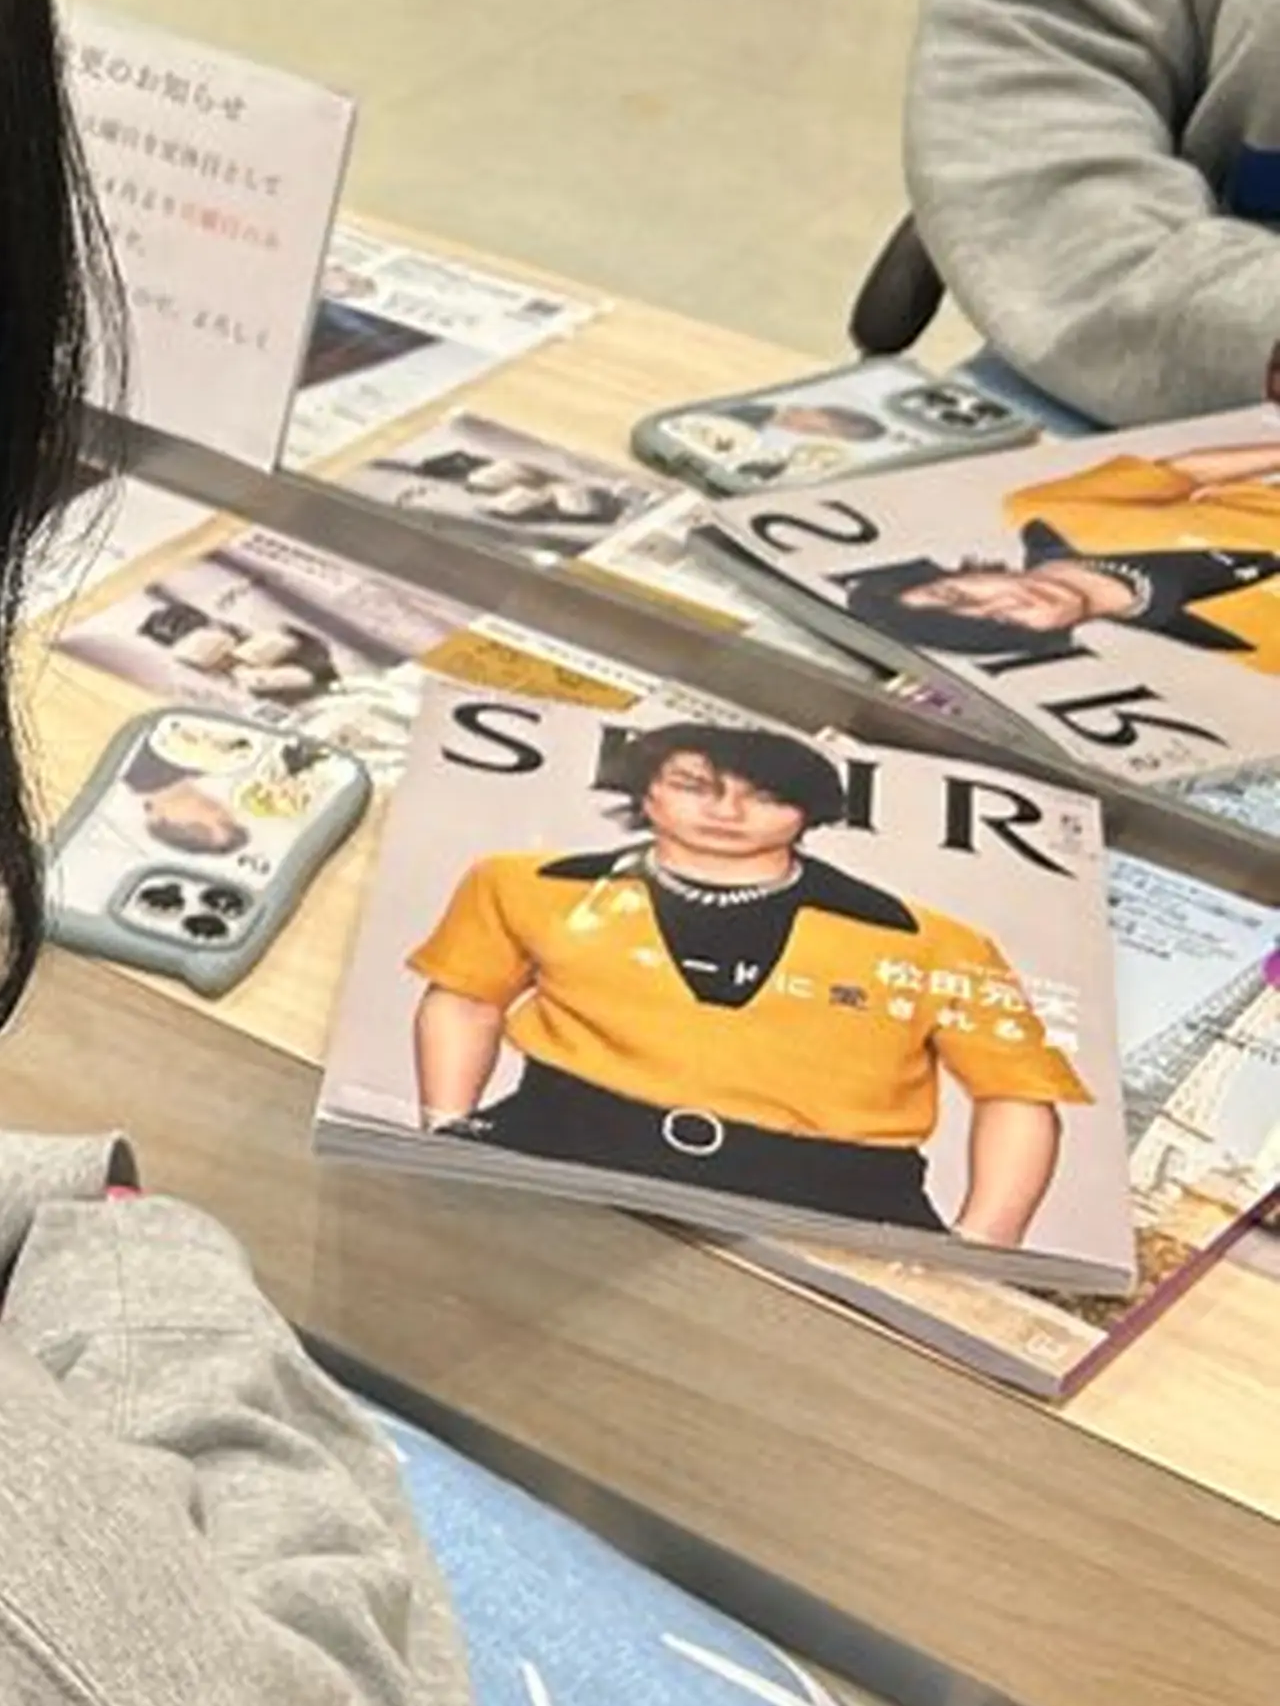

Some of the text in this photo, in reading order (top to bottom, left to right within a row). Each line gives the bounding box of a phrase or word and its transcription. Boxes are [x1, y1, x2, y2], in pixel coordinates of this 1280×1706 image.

[56, 35, 247, 121] 更のお知らせ
[441, 702, 1077, 881] SR
